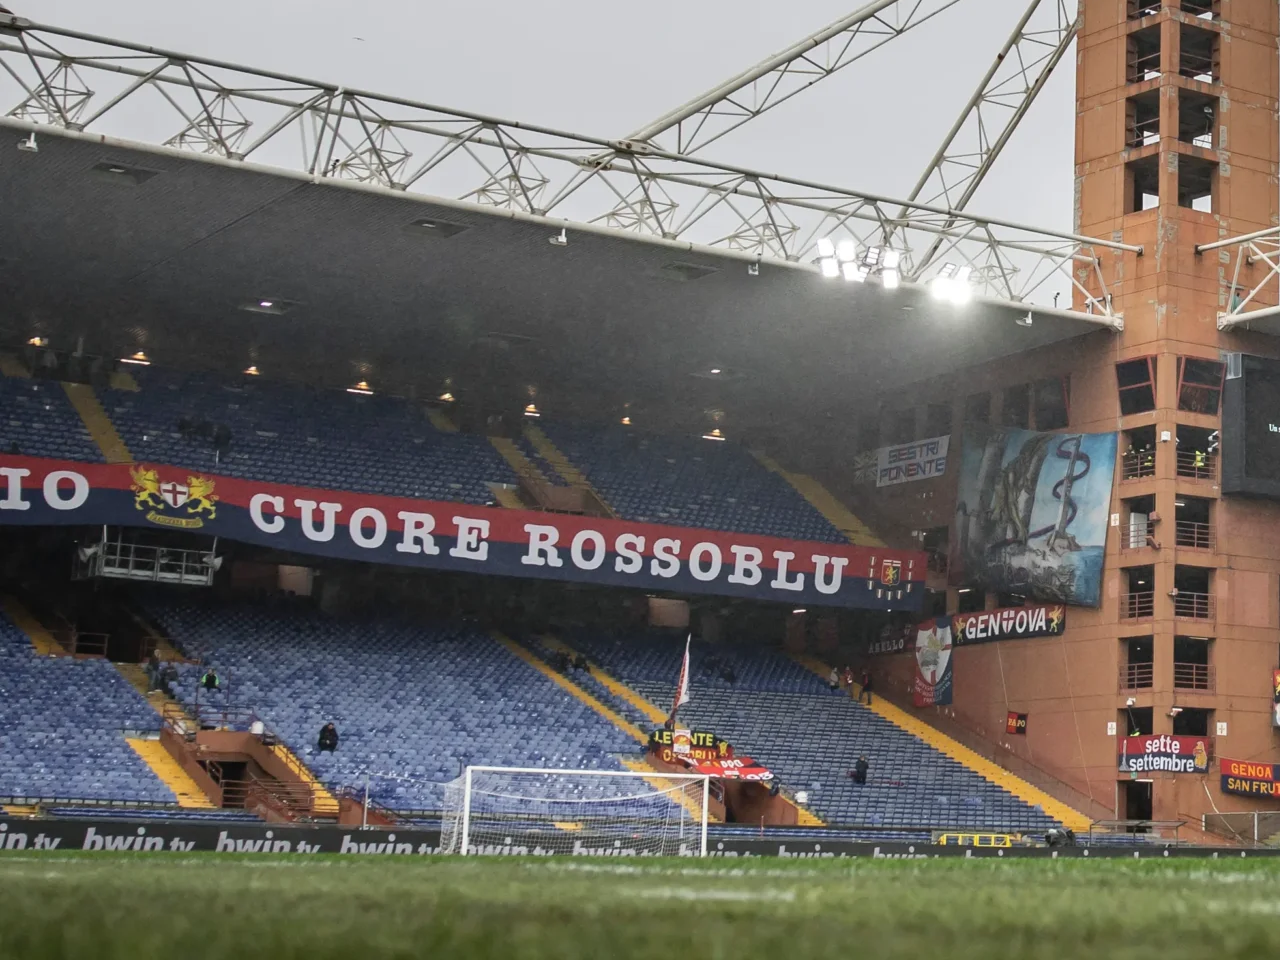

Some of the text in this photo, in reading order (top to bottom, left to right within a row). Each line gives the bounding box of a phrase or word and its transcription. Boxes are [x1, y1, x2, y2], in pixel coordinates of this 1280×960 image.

[1269, 424, 1277, 432] Un
[888, 440, 939, 464] SESTRI
[880, 457, 945, 482] PONENTE
[249, 493, 848, 594] CUORE ROSSOBLU
[654, 731, 713, 746] LENTE
[1145, 735, 1180, 753] sette
[1129, 754, 1194, 772] settembre
[1231, 764, 1272, 778] GENOA
[1228, 778, 1250, 790] SAN
